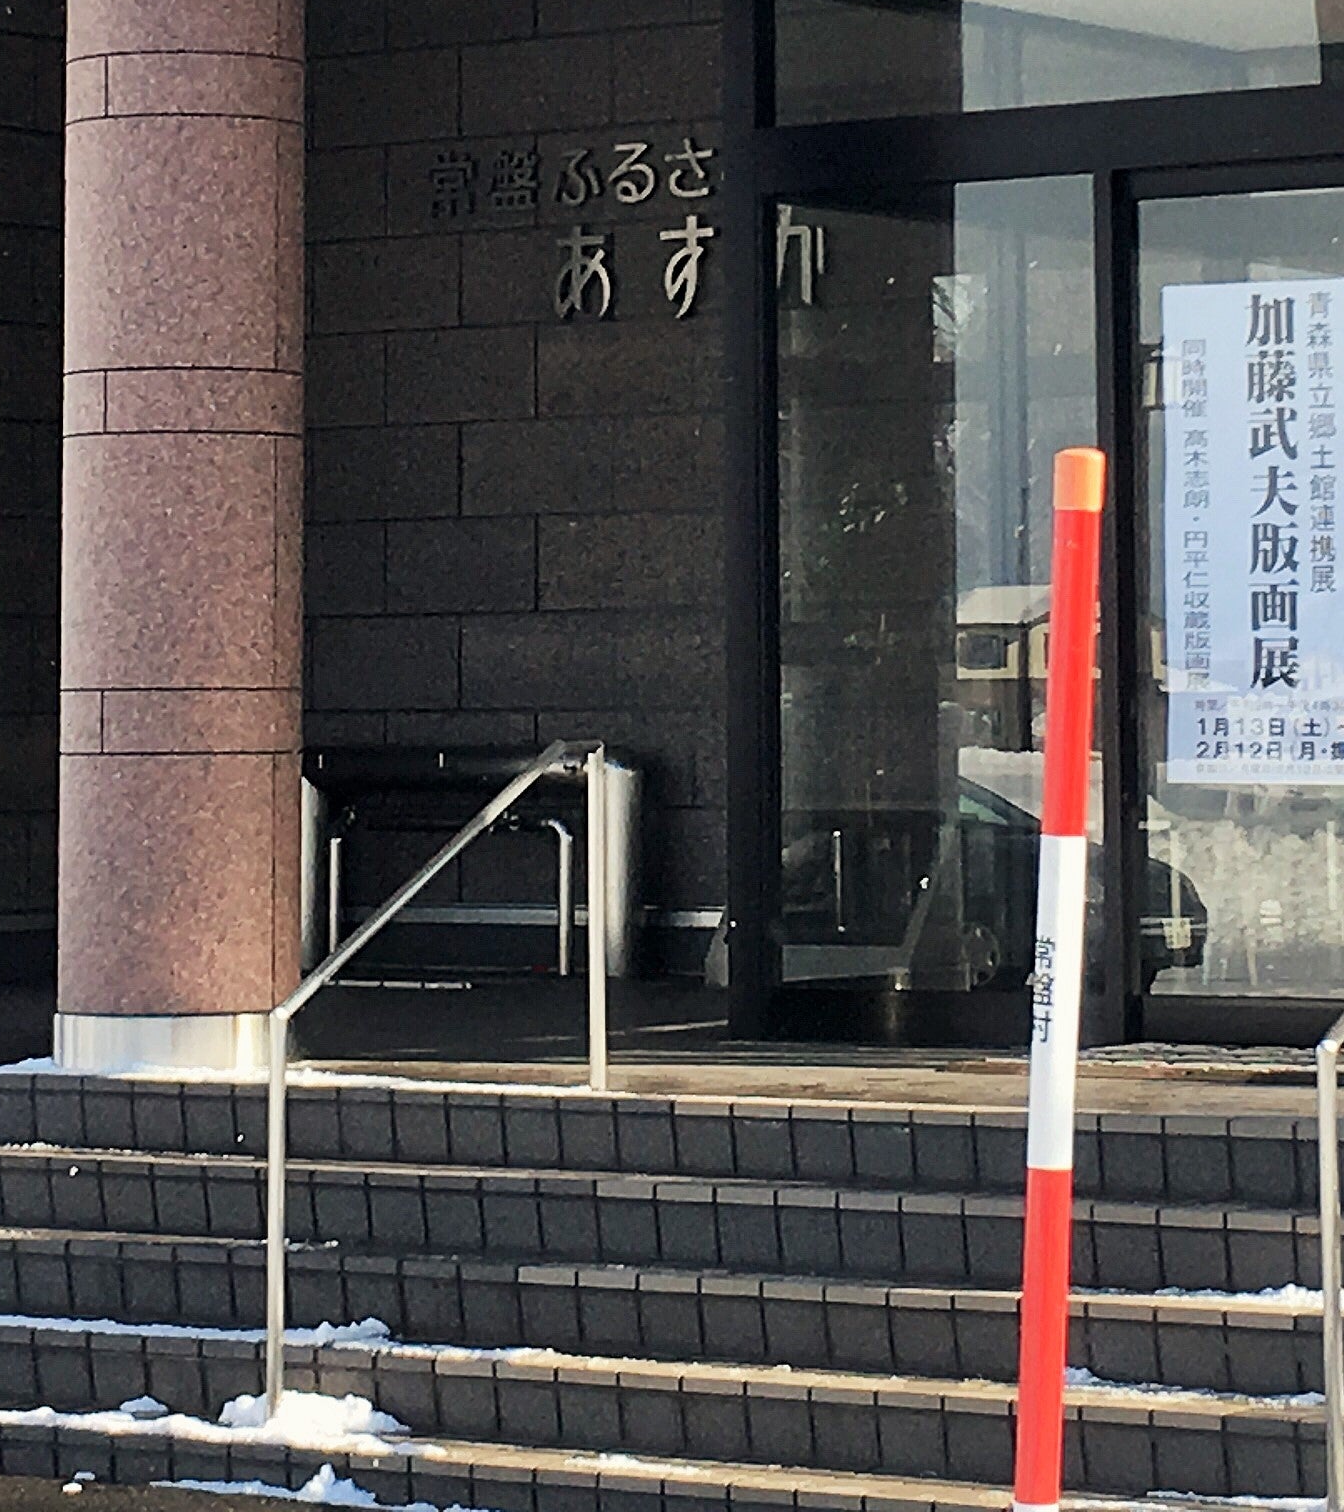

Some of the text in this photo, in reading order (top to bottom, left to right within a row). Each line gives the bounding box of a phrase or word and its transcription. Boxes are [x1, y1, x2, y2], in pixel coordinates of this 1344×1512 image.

[1244, 293, 1301, 691] 加藤武夫版画展
[1307, 291, 1337, 594] 青森県立郷土館連携展
